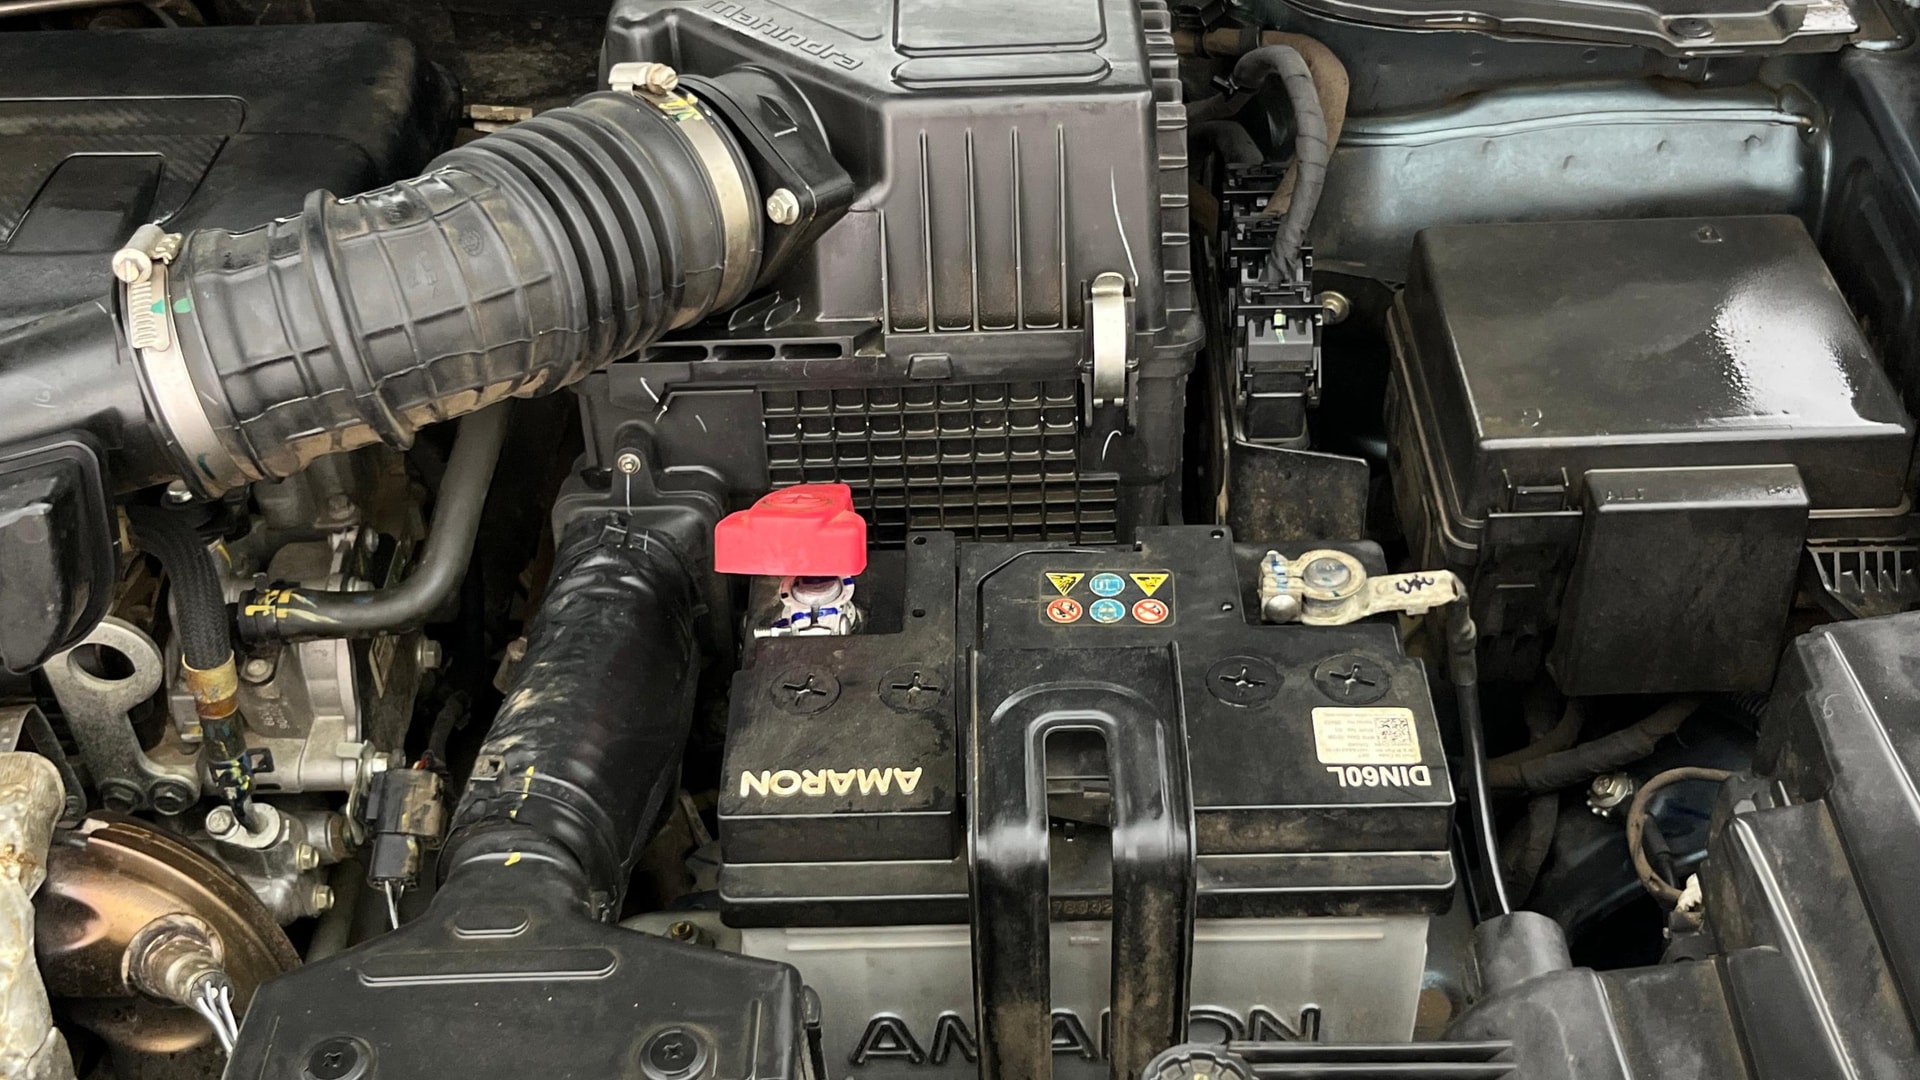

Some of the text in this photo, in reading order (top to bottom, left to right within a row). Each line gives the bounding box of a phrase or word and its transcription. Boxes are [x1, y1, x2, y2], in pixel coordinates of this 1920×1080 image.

[739, 767, 923, 797] AMARON
[1327, 765, 1432, 788] DIN60L
[848, 1003, 1321, 1065] AMAON
